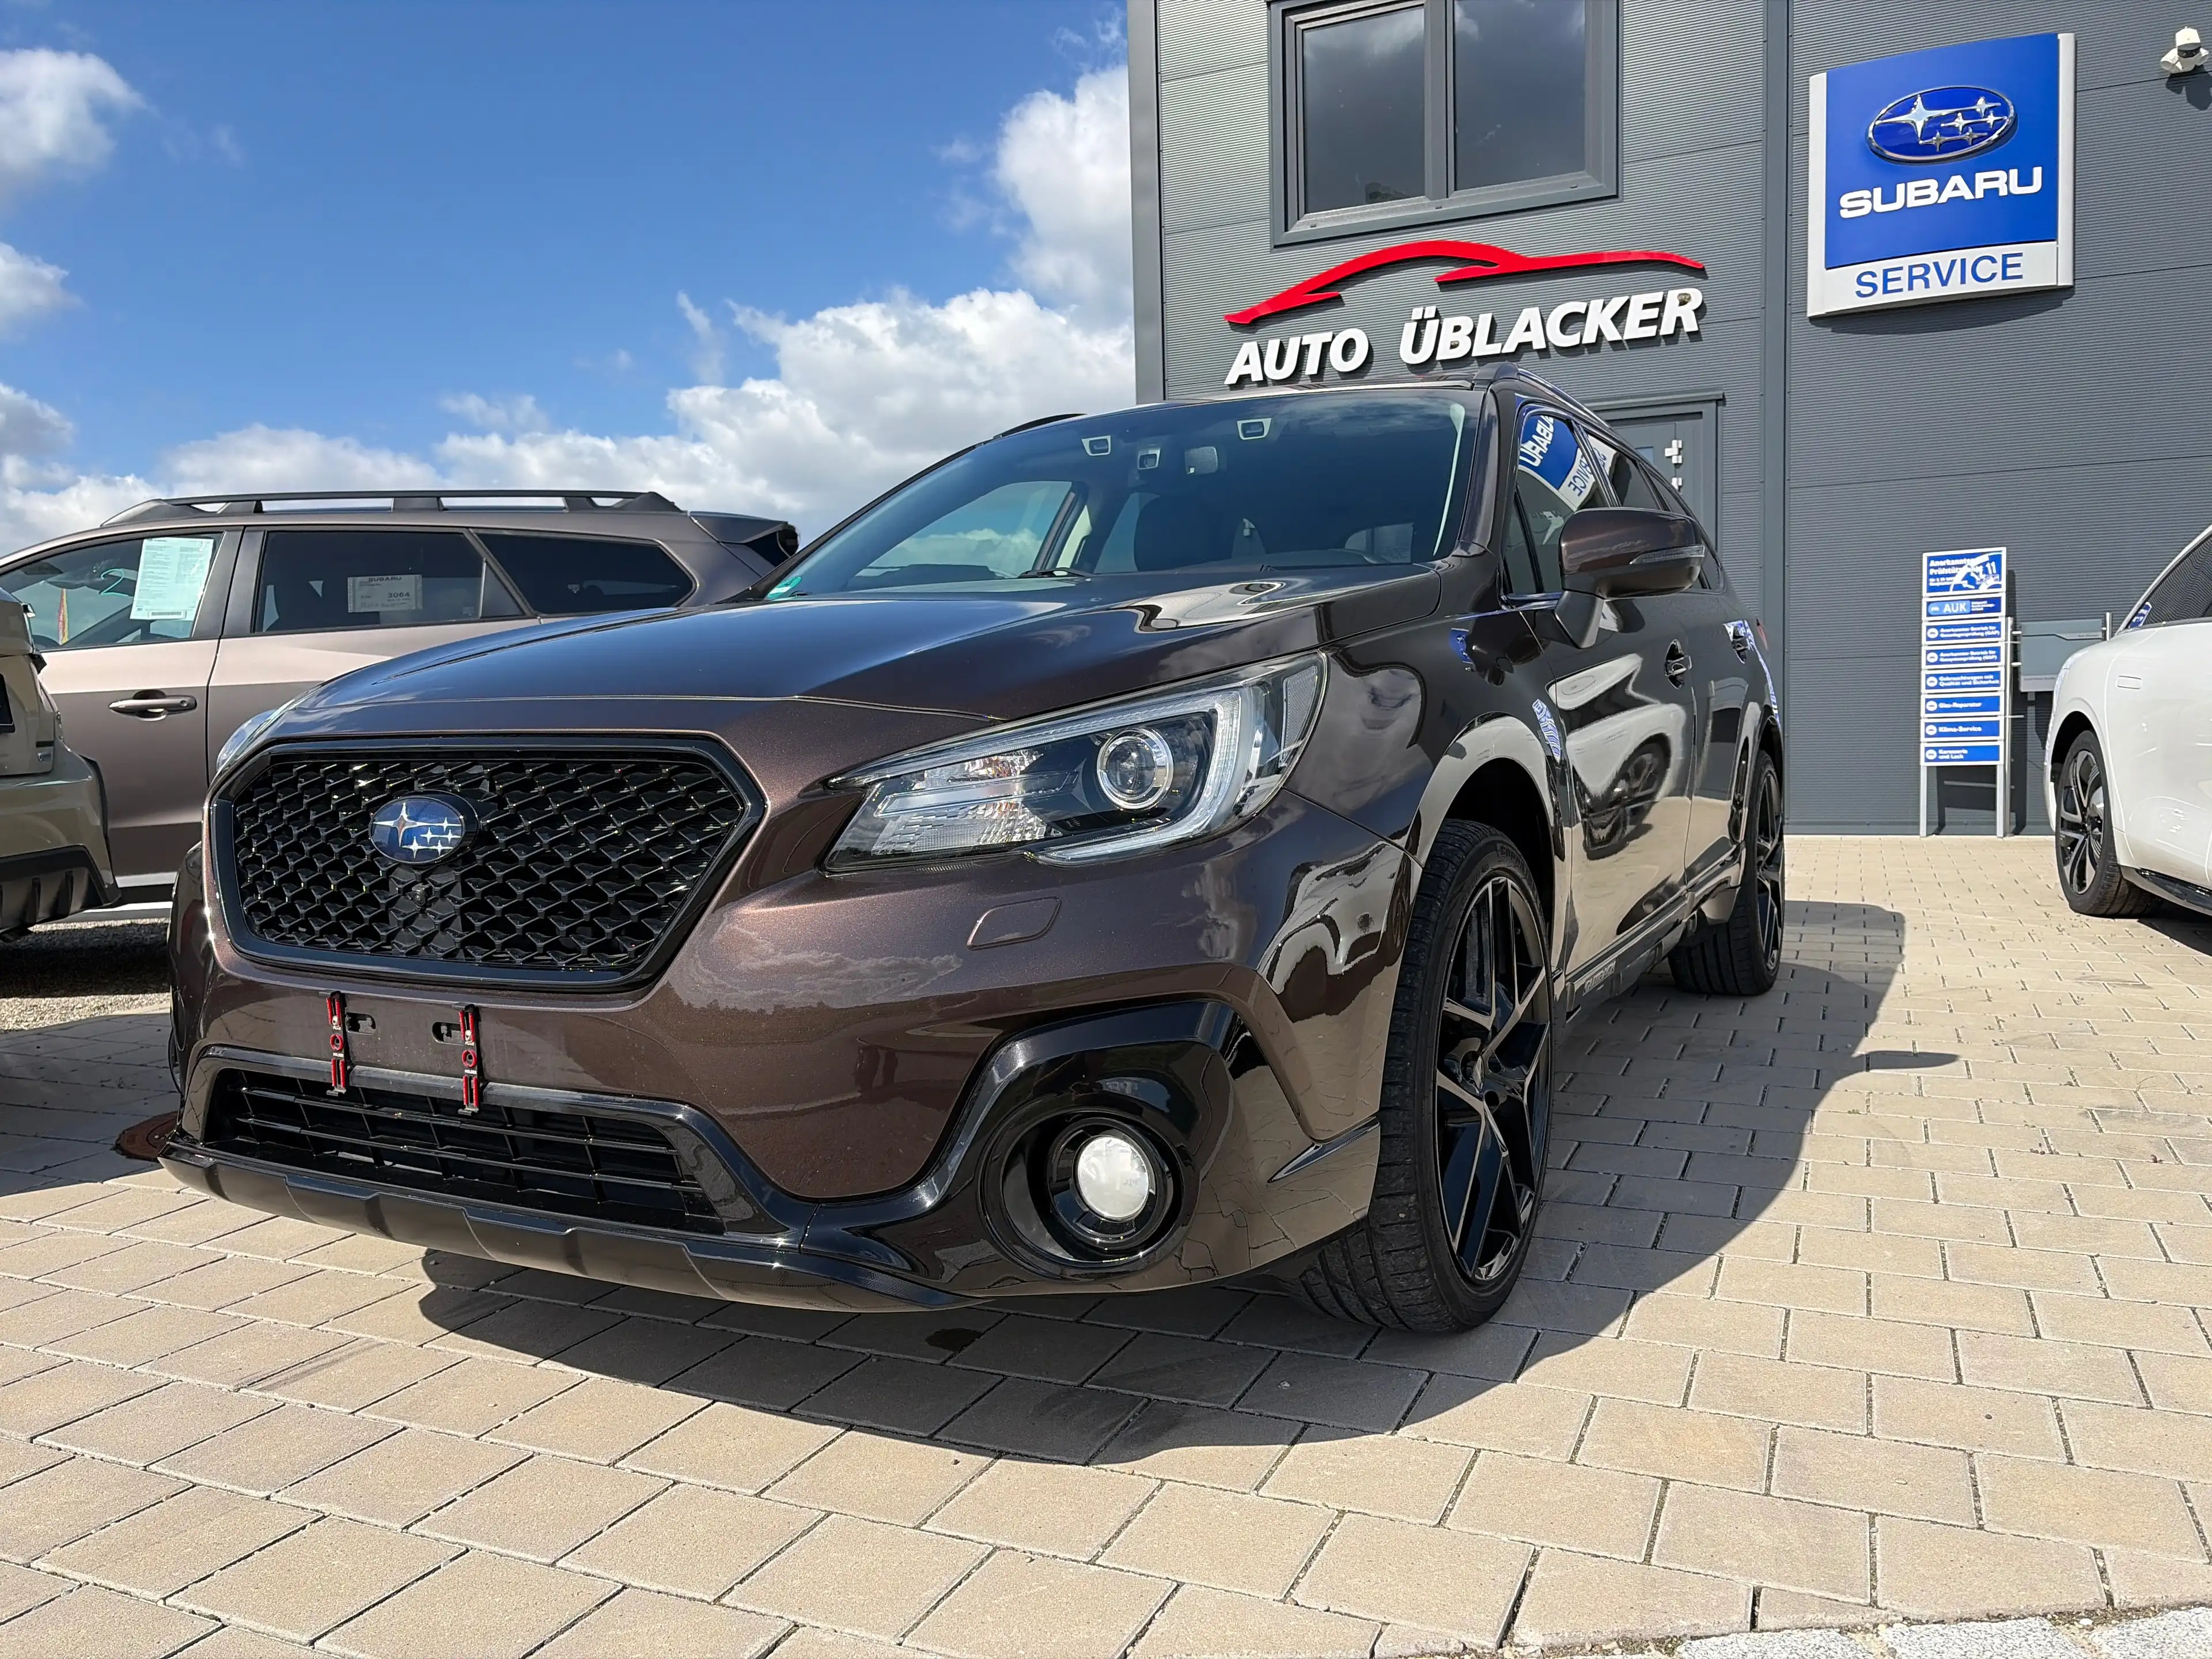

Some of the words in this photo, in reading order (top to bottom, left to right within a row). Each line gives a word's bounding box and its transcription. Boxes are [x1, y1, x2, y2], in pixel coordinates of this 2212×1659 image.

[1839, 166, 2042, 219] SUBARU
[1855, 252, 2024, 298] SERVICE
[1224, 328, 1369, 385] AUTO
[1399, 287, 1703, 365] ÜBLACKER
[1943, 602, 1967, 613] AUK
